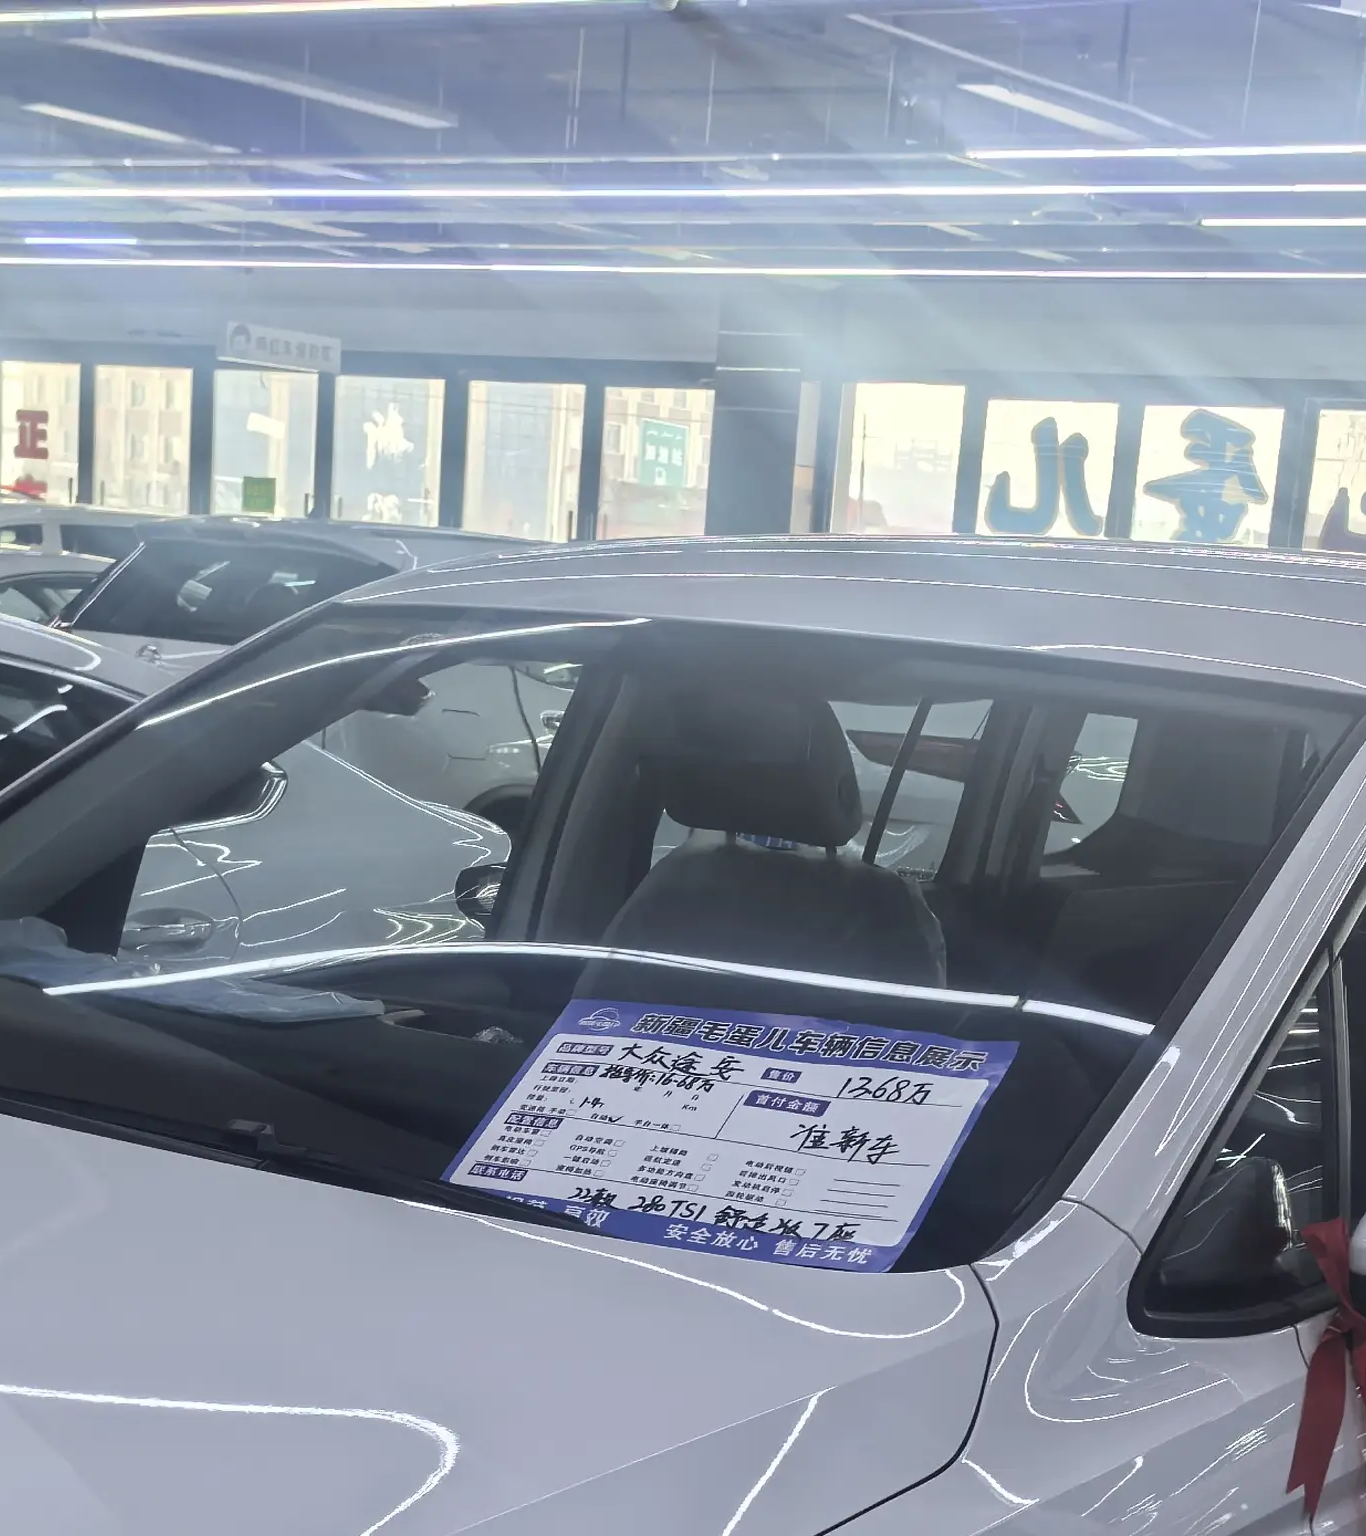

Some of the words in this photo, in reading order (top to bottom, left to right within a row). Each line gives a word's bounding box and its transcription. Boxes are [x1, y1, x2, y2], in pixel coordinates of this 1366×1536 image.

[631, 1013, 988, 1071] 新疆毛蛋儿车辆信息展示
[544, 1063, 597, 1076] 车辆信息
[767, 1069, 797, 1083] 售价
[755, 1093, 820, 1114] 首付金额
[506, 1114, 559, 1129] 配置信息
[637, 1165, 694, 1180] 多功能方向盘
[664, 1223, 758, 1251] 安全放心
[773, 1239, 872, 1264] 售后无忧
